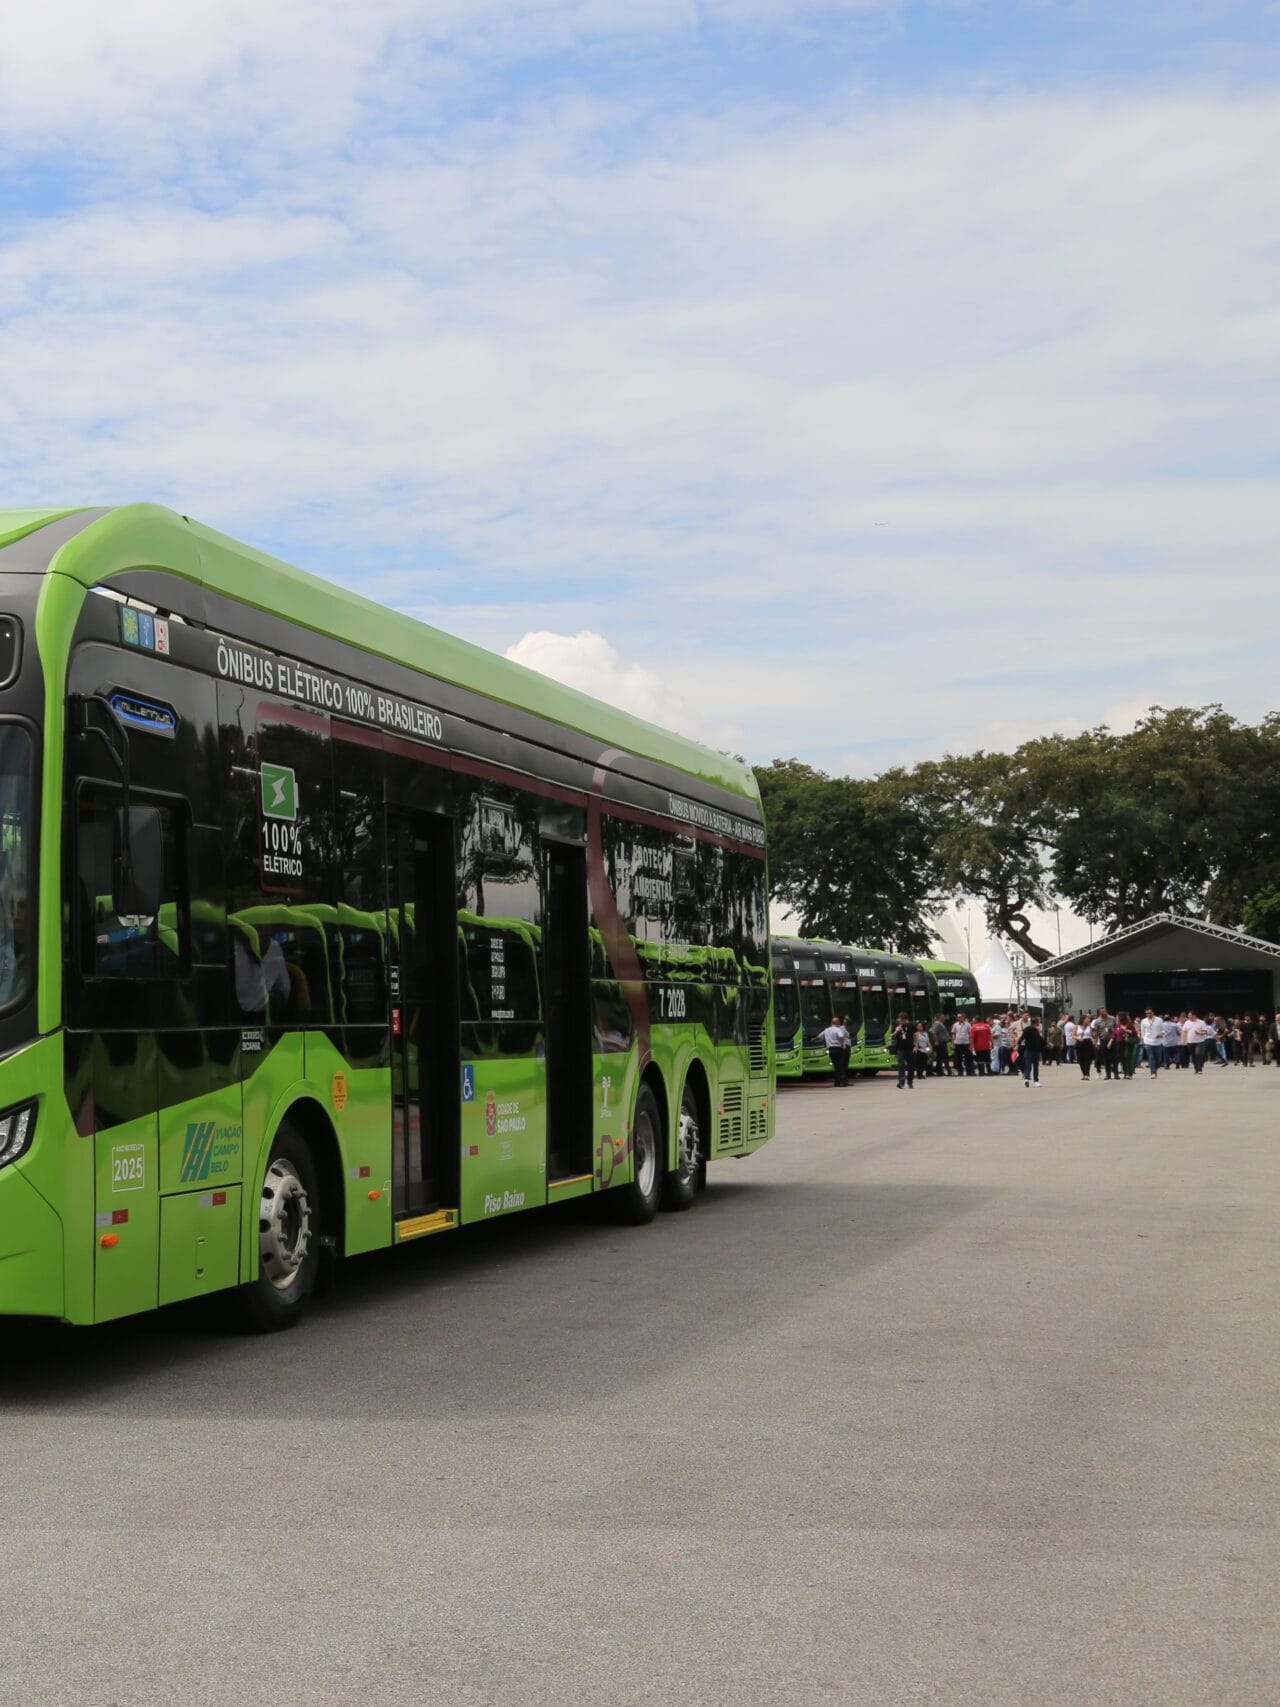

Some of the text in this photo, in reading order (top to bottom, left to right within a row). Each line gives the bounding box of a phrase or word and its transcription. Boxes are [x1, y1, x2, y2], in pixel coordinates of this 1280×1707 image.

[216, 637, 443, 741] ÔNIBUS ELÉTRICO 100% BRASILEIRO
[262, 821, 302, 855] 100%
[263, 851, 302, 876] ELÉTRICO
[658, 988, 686, 1017] 7 2028
[114, 1157, 143, 1182] 2025
[484, 1188, 525, 1215] Piso Baixo
